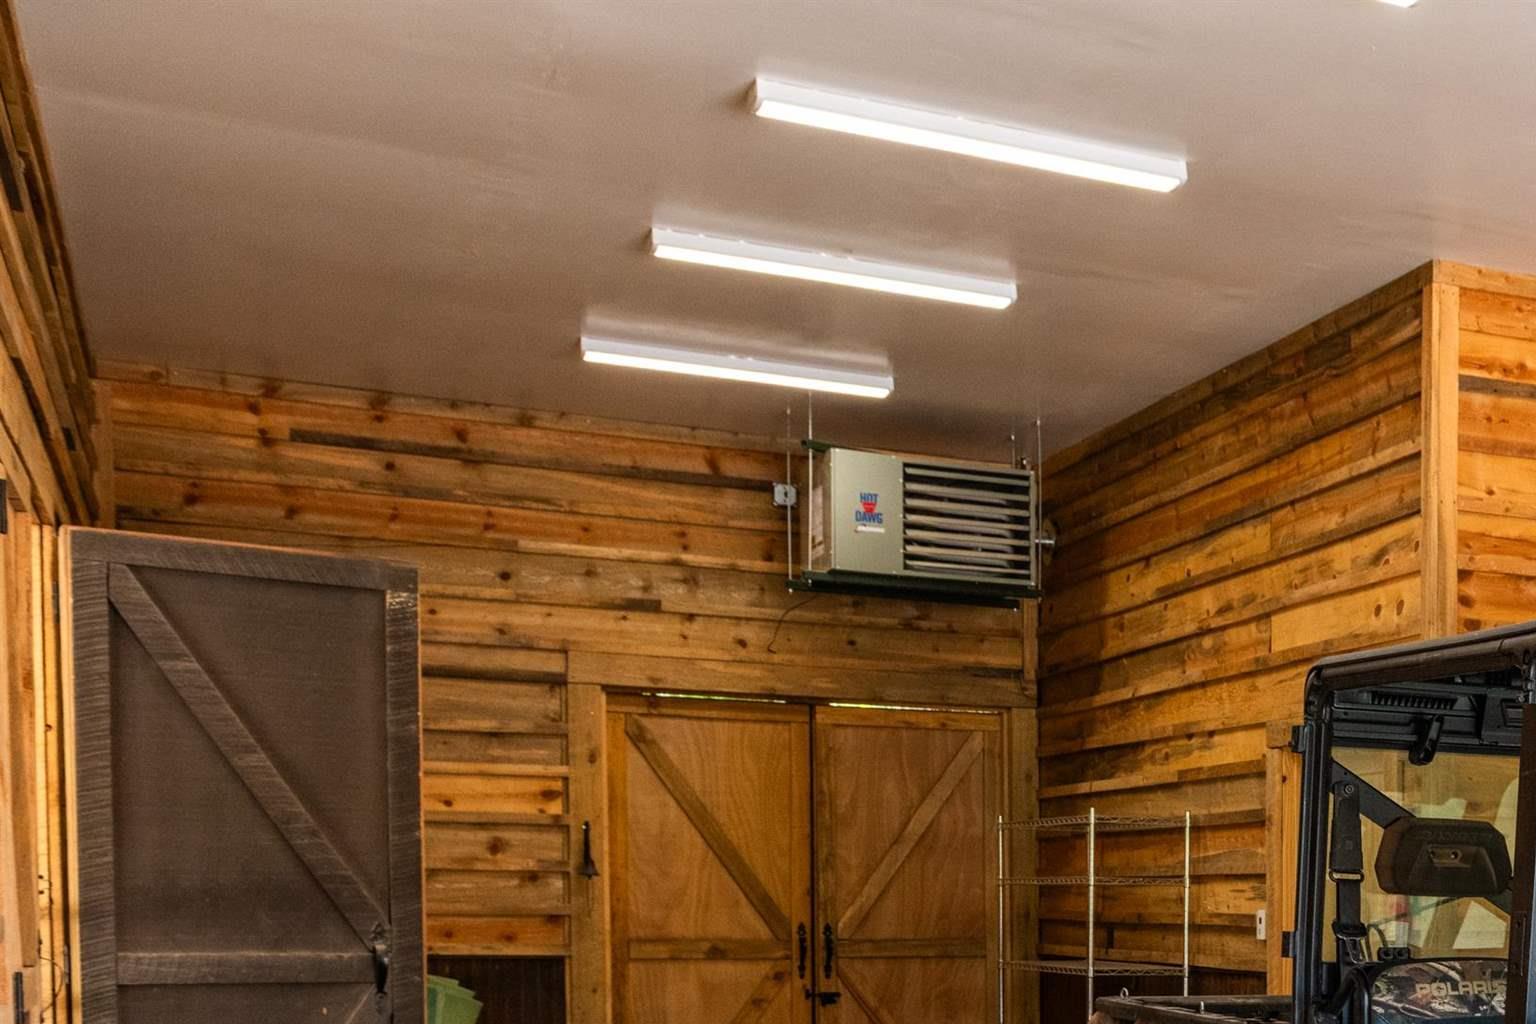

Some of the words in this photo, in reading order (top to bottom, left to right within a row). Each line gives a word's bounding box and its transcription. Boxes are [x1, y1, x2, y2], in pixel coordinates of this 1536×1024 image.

[860, 492, 879, 503] HOT
[855, 510, 884, 524] DAWG
[1415, 981, 1507, 997] POLARIS
